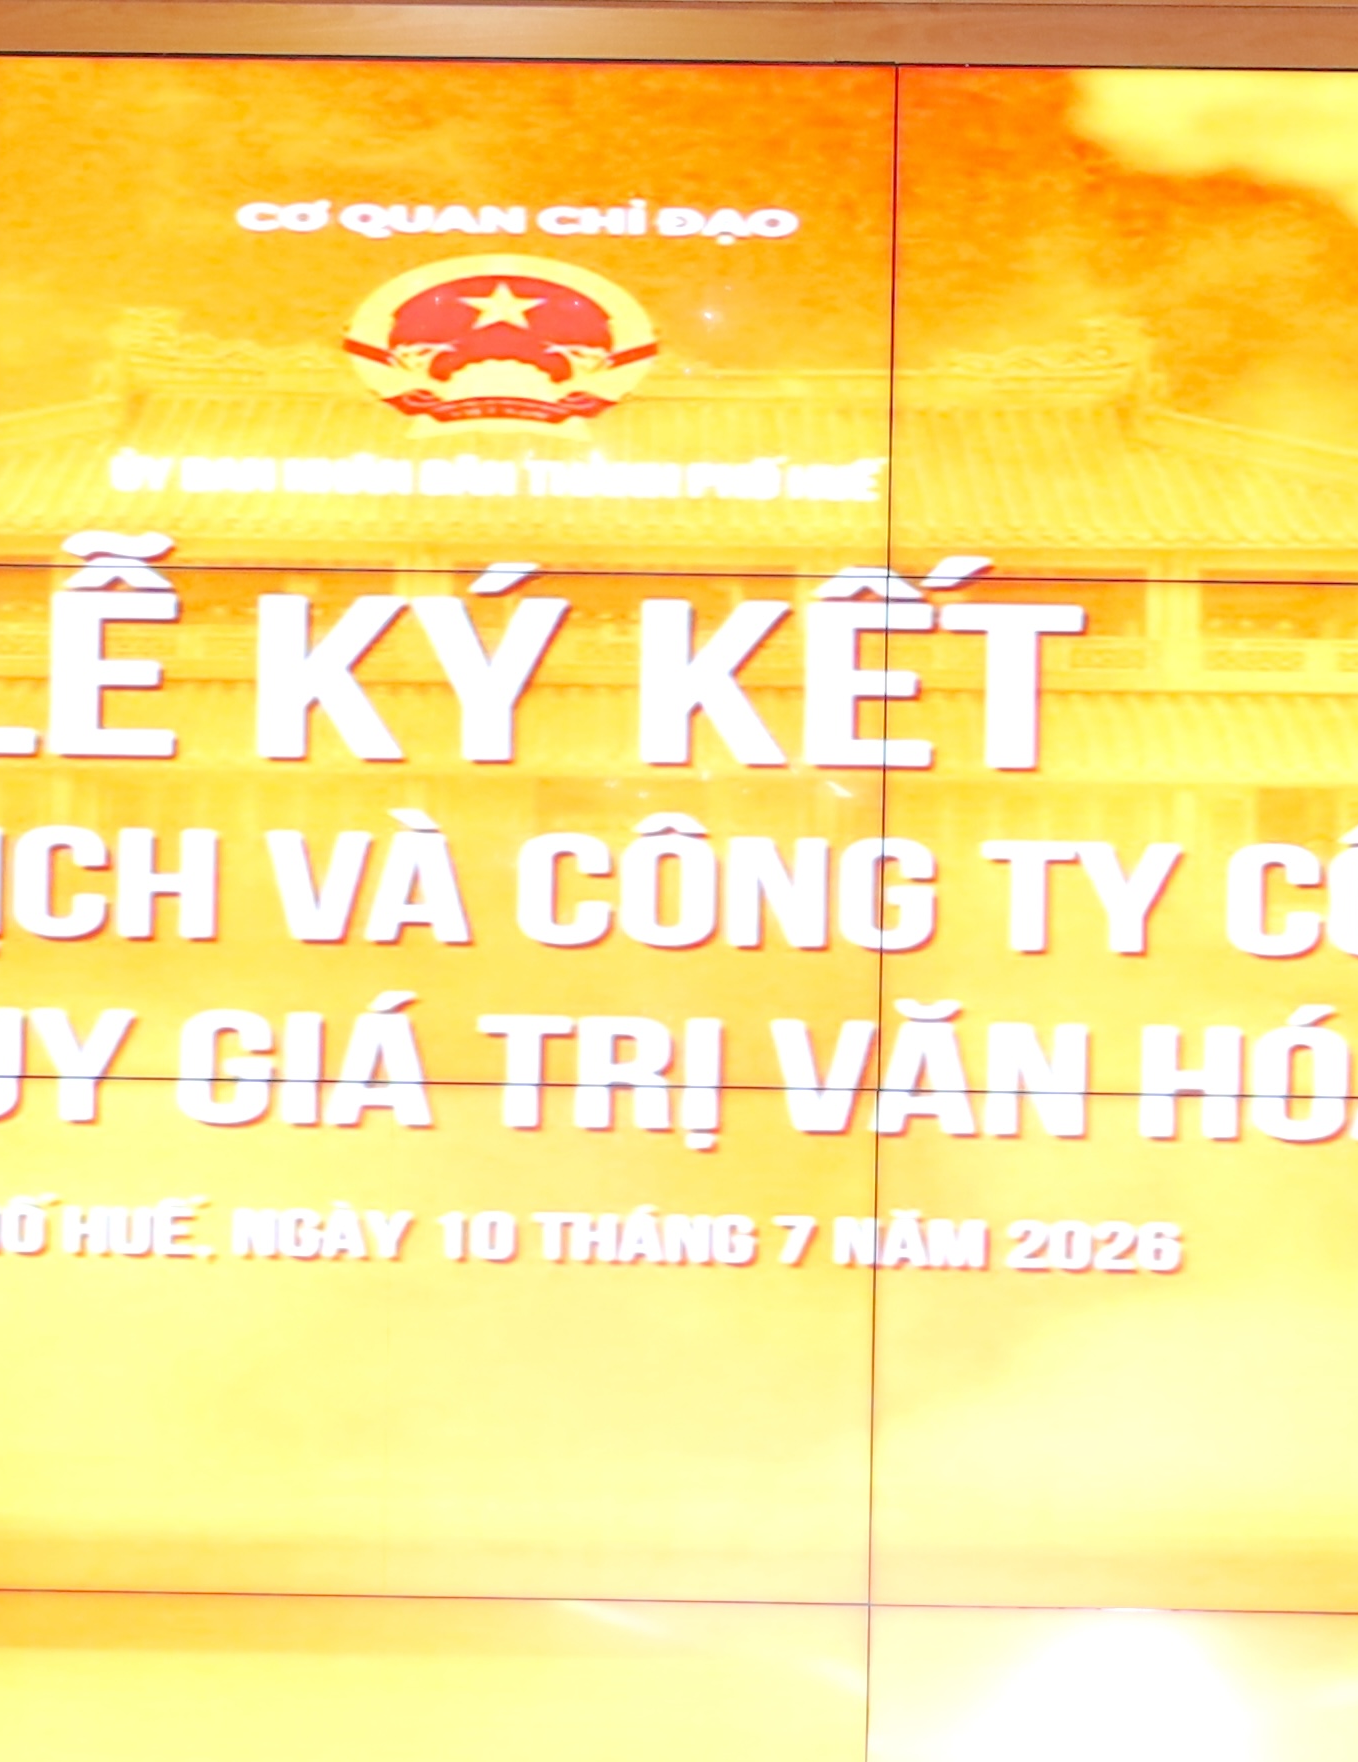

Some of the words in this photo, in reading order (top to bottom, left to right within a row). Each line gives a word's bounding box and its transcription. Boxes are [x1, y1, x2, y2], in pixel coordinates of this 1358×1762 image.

[237, 201, 330, 231] CƠ
[339, 204, 526, 238] QUAN
[656, 208, 798, 244] ĐẠO
[256, 562, 568, 760] KÝ
[638, 556, 1083, 768] KẾT
[266, 808, 469, 942] VÀ
[517, 813, 935, 949] CÔNG
[980, 840, 1183, 952] TY
[173, 991, 432, 1126] GIÁ
[478, 1015, 722, 1149] TRỊ
[771, 999, 1089, 1136] VĂN
[231, 1201, 411, 1258] NGÀY
[437, 1211, 515, 1259] 10
[531, 1204, 756, 1263] THÁNG
[773, 1216, 815, 1263] 7
[833, 1209, 987, 1267] NĂM
[1005, 1220, 1181, 1270] 2026
